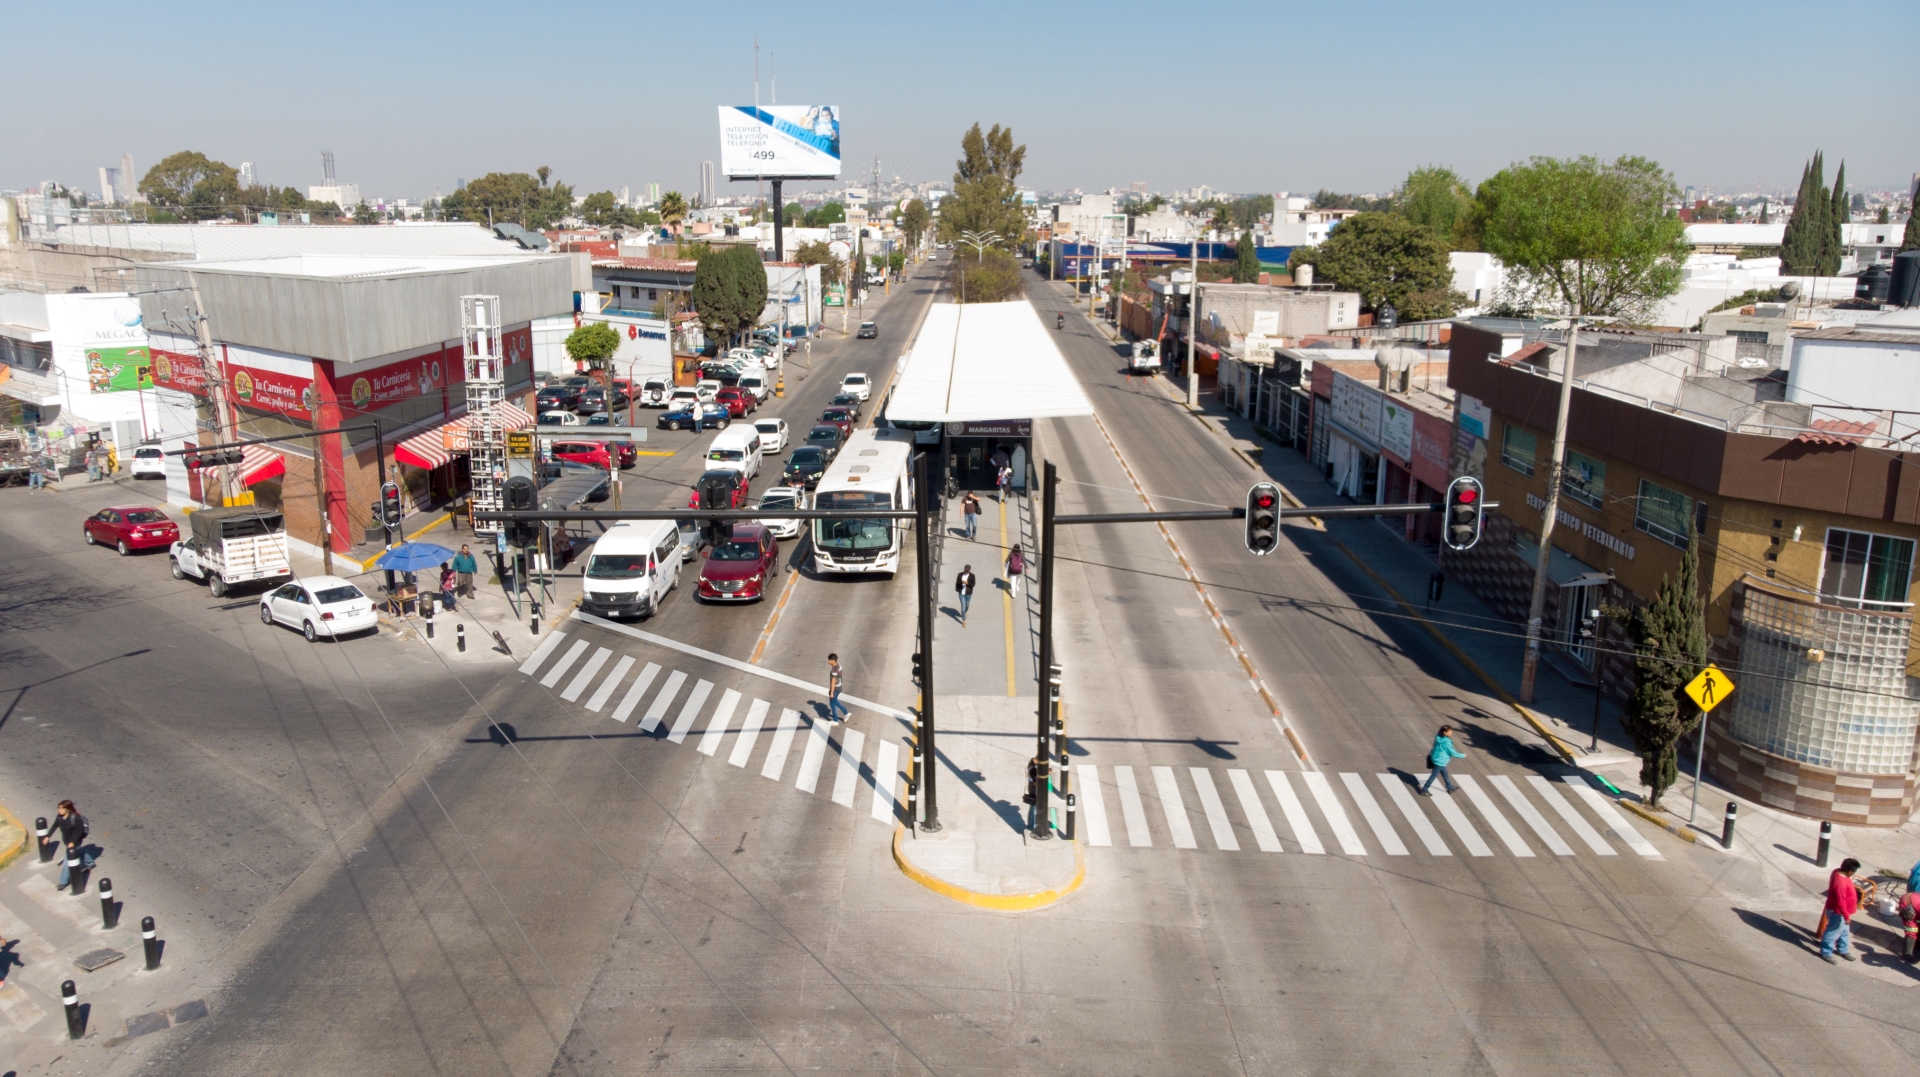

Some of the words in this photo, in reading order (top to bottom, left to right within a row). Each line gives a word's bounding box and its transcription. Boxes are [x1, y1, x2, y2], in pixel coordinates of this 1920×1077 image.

[638, 328, 667, 341] Banamex
[1257, 342, 1269, 350] BAR
[373, 378, 380, 391] Tu
[381, 368, 411, 388] Carnicería
[255, 378, 262, 391] Tu
[263, 380, 296, 398] Carnicería
[355, 384, 368, 400] RYC
[389, 386, 400, 400] pollo
[968, 426, 1011, 434] MARGARITAS
[1583, 522, 1636, 561] VETERINARIO
